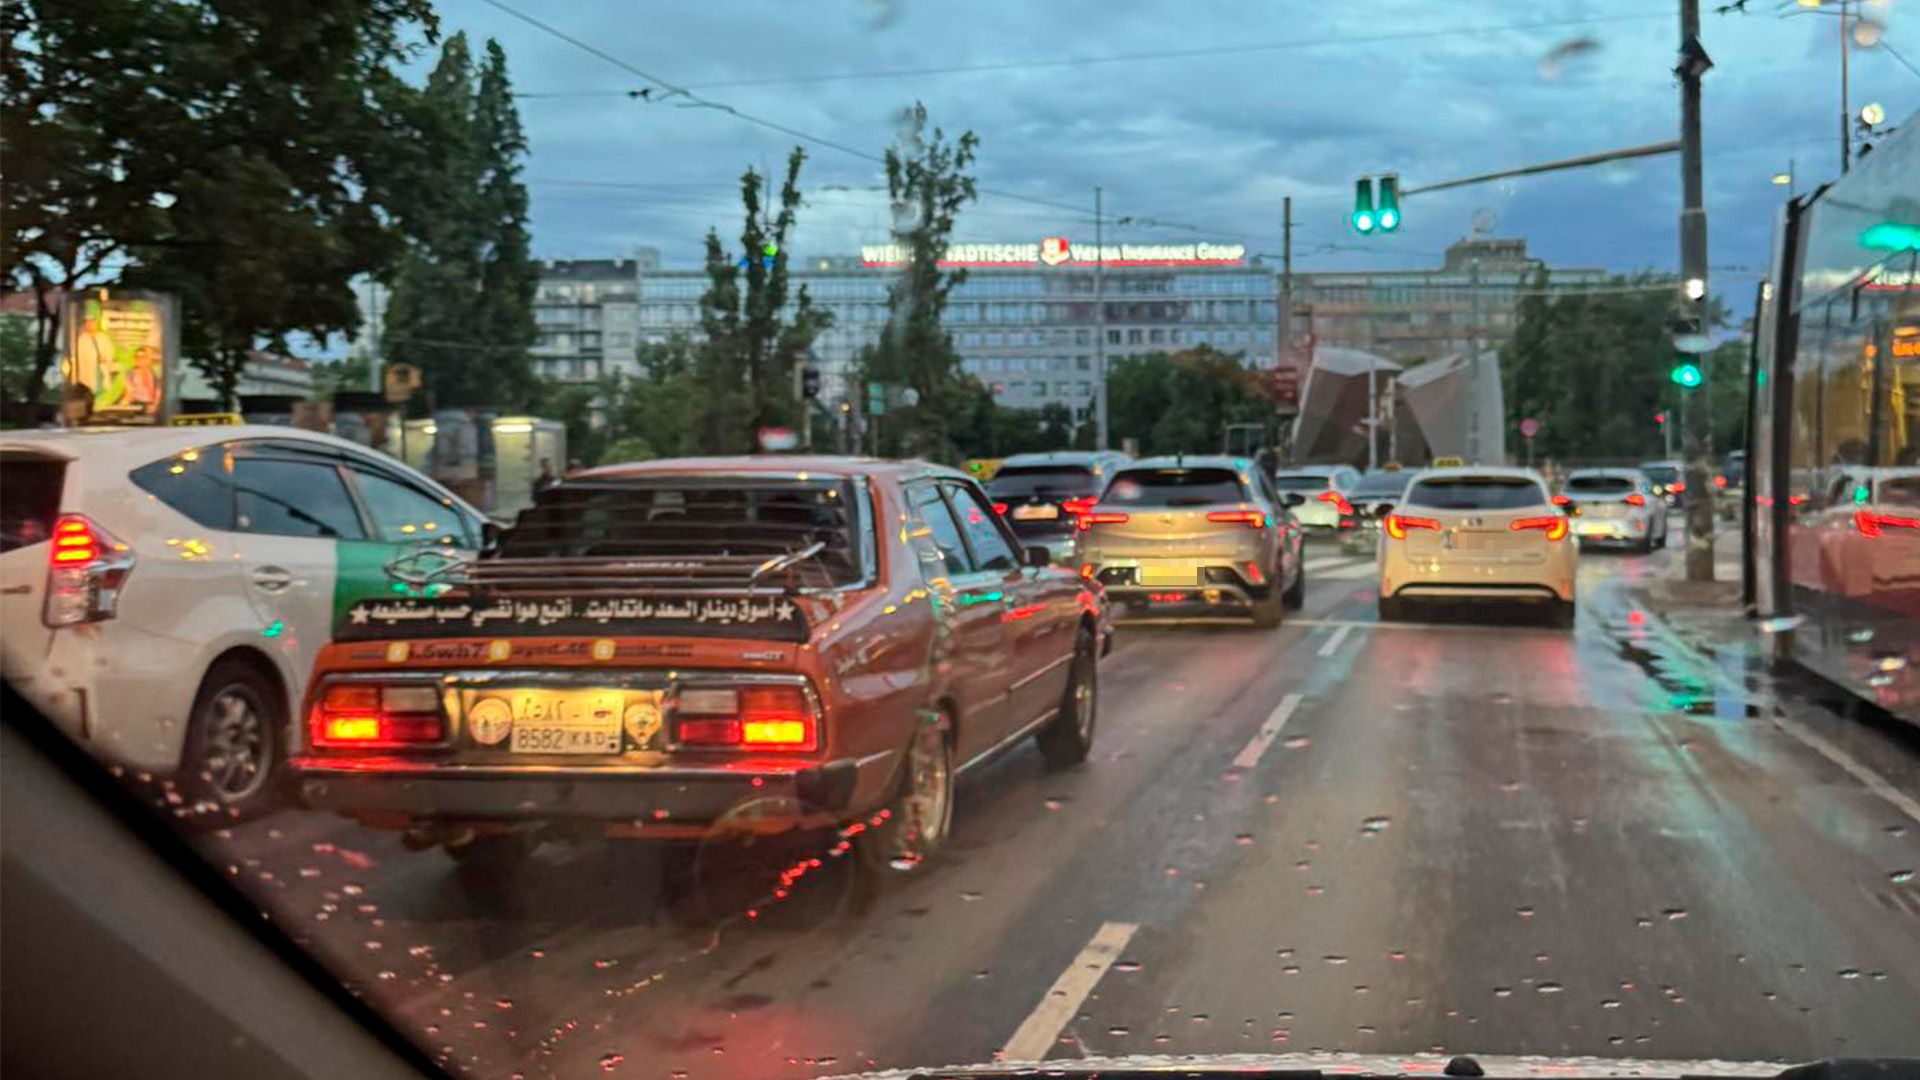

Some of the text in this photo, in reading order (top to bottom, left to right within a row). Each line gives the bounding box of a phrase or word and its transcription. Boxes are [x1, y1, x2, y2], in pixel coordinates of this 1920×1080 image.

[654, 598, 698, 619] السعد
[697, 599, 738, 625] دينار
[517, 727, 565, 750] 8582
